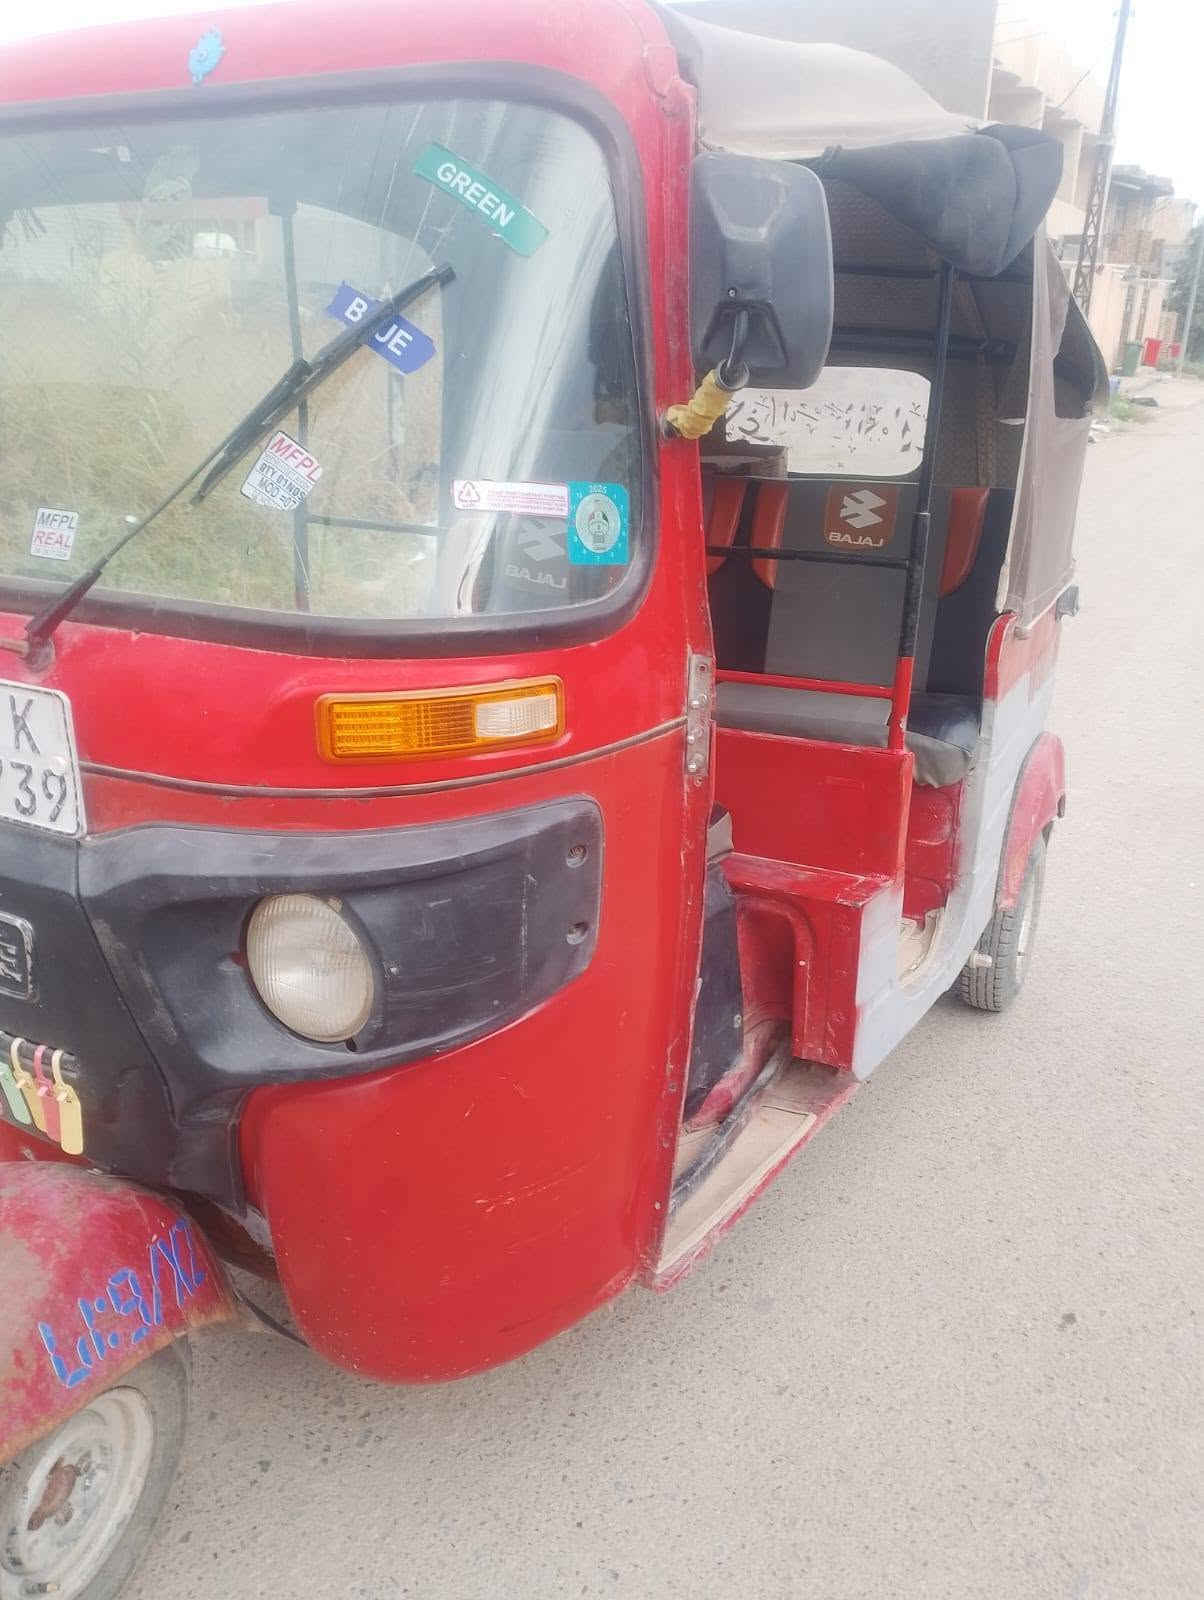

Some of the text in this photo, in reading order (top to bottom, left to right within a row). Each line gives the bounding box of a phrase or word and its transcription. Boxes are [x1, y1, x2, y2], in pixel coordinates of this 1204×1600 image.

[437, 163, 515, 227] GREEN
[270, 437, 320, 482] MFPL
[37, 511, 74, 530] MFPL
[34, 530, 71, 548] REAL
[829, 532, 884, 547] BAJAJ
[9, 694, 41, 755] K
